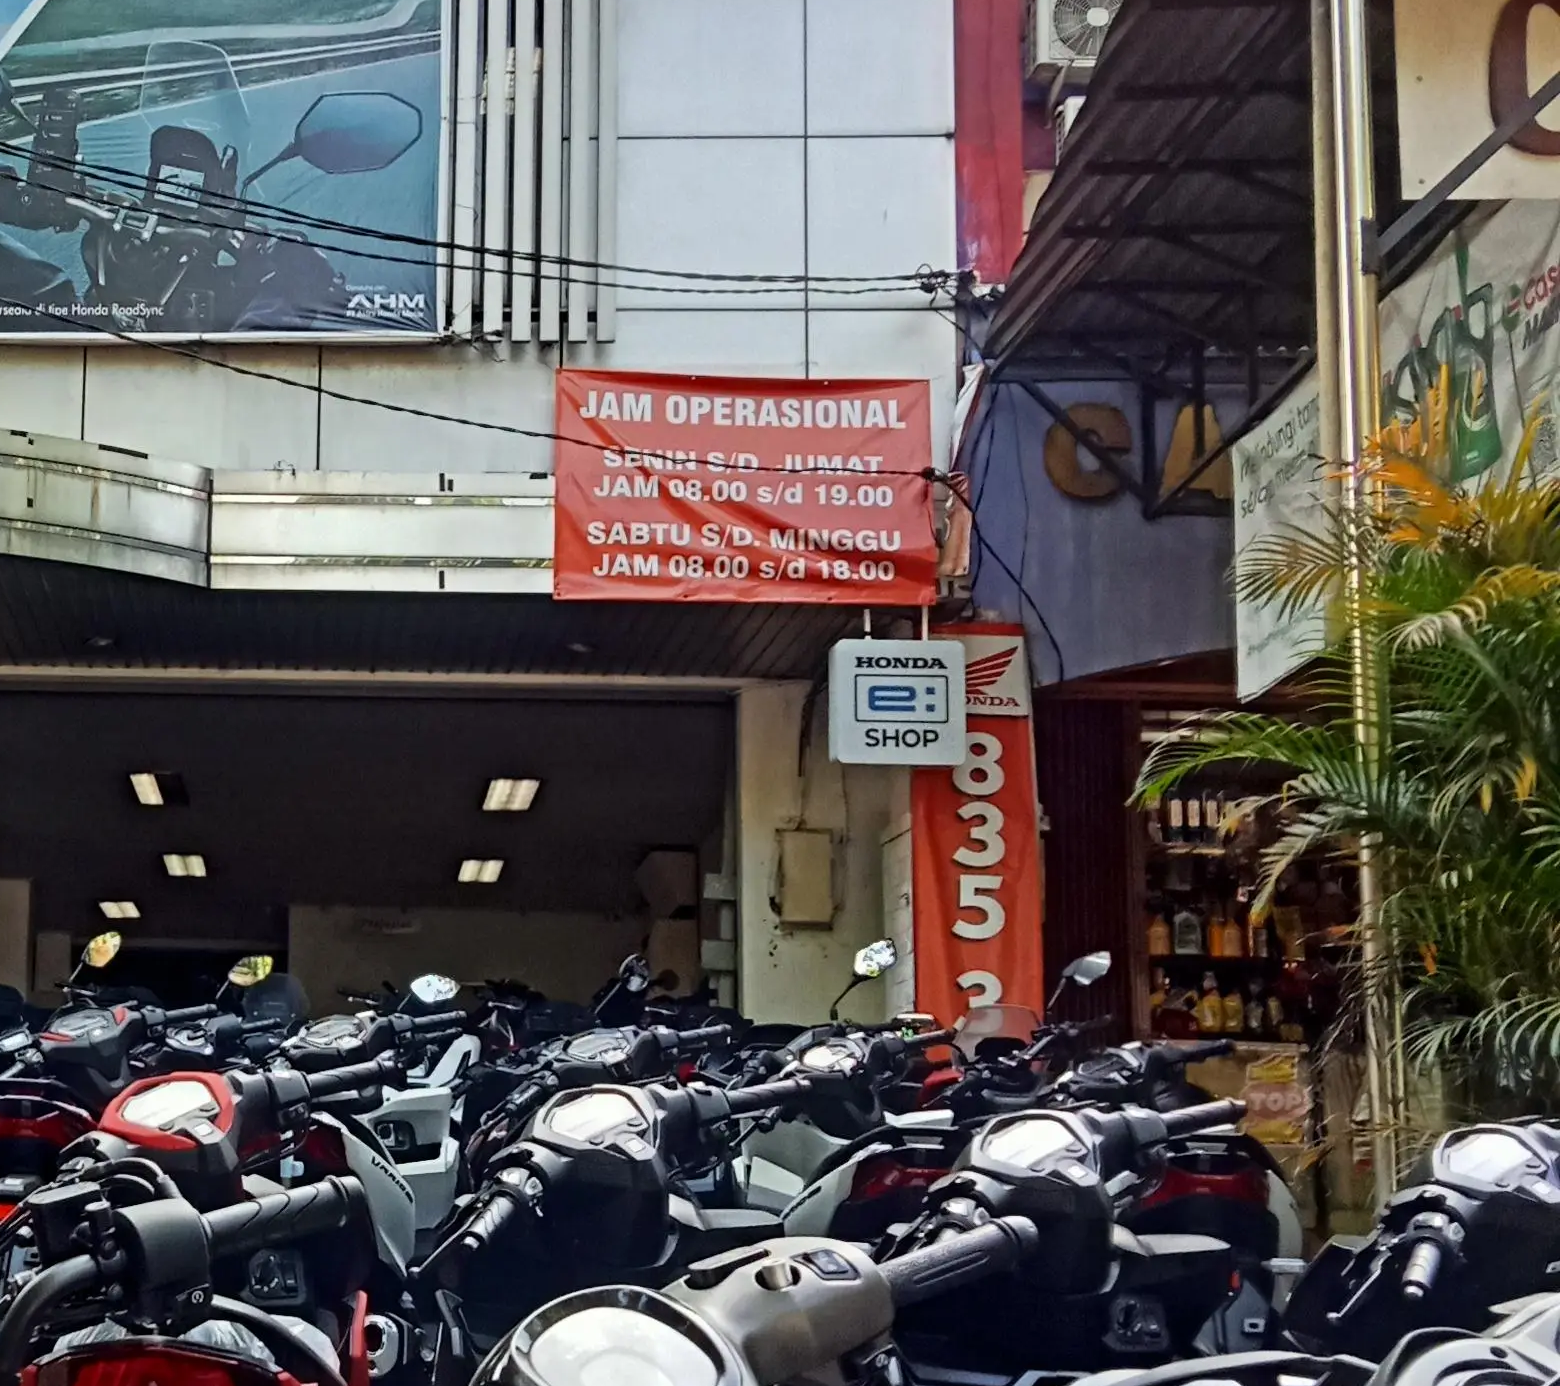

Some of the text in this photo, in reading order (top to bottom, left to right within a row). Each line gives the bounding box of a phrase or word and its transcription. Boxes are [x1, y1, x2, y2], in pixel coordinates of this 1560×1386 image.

[71, 301, 109, 316] Honda
[111, 301, 165, 319] RoadSync
[347, 293, 425, 309] AHM
[579, 390, 907, 430] JAM OPERASIONAL
[603, 446, 697, 471] SENIN
[593, 474, 895, 508] JAM 08.00 s/d 19.00
[587, 521, 902, 553] SABTU S/D. MINGGU
[592, 553, 896, 583] JAM 08.00 s/d 18.00
[854, 656, 948, 670] HONDA
[966, 696, 1021, 708] ONDA
[864, 727, 940, 750] SHOP
